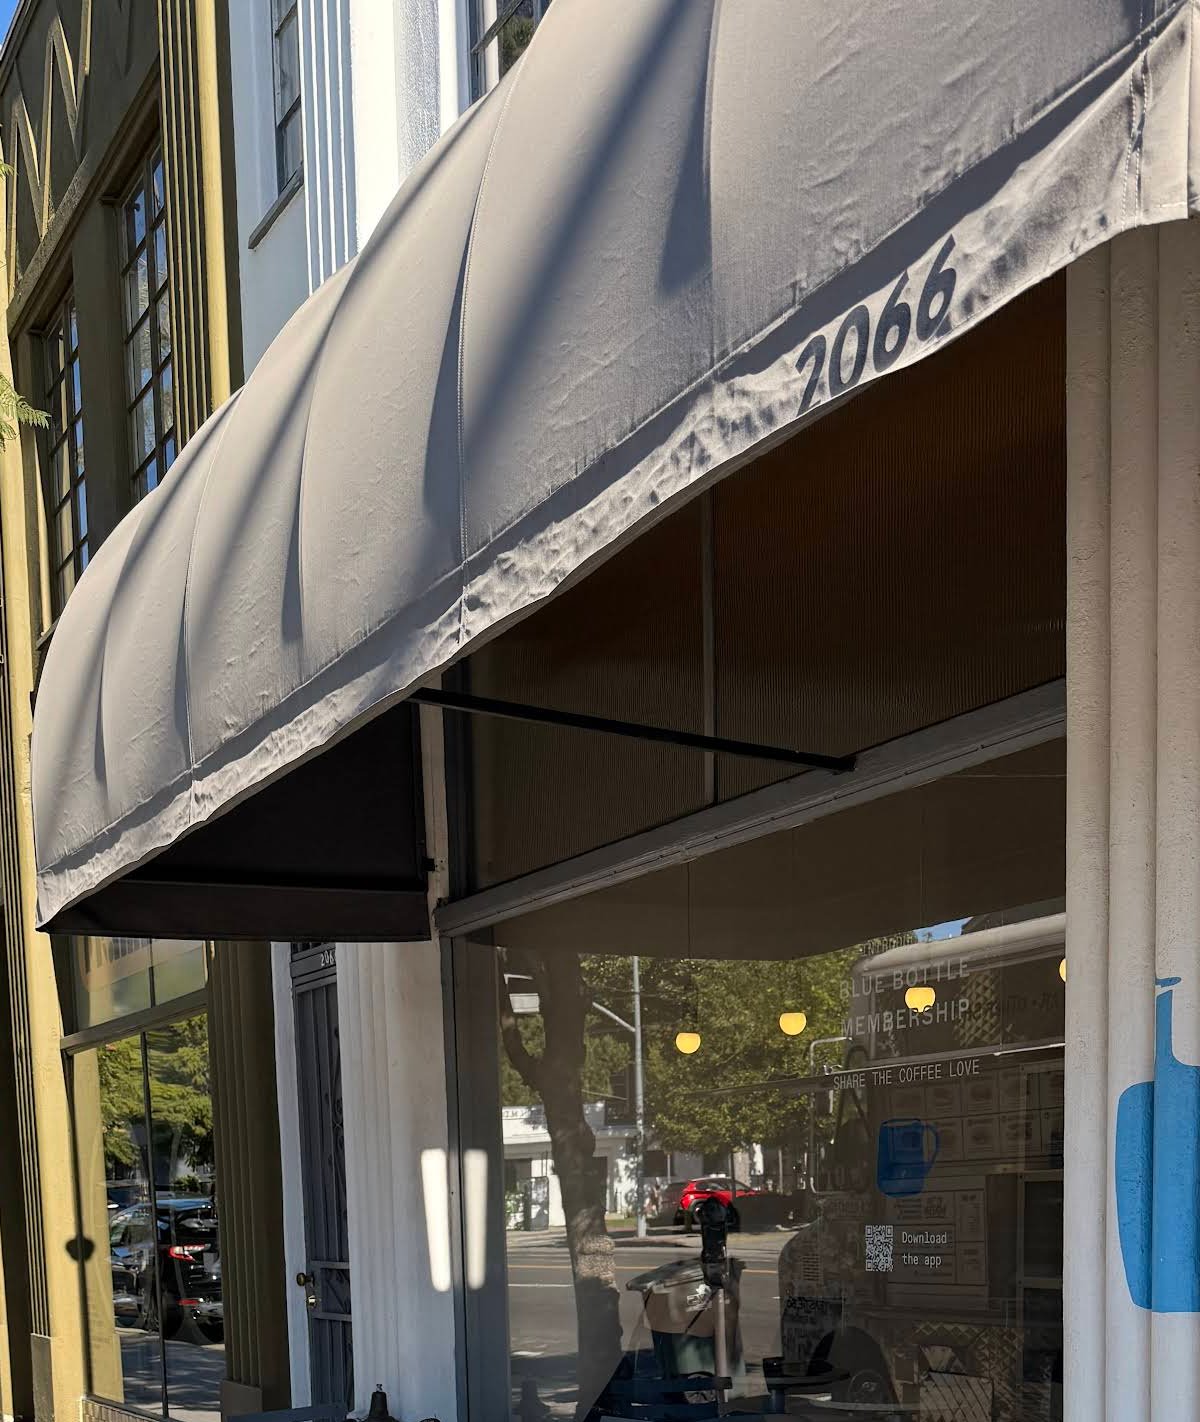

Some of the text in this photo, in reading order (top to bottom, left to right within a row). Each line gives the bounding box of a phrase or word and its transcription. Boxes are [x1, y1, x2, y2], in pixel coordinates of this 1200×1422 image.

[796, 234, 957, 417] 2066
[840, 957, 970, 1000] BLUE BOTTLE
[841, 998, 970, 1038] MEMBERSHIP
[833, 1058, 980, 1090] SHARE THE COFFEE LOVE
[902, 1231, 947, 1244] Download
[902, 1253, 942, 1268] the app
